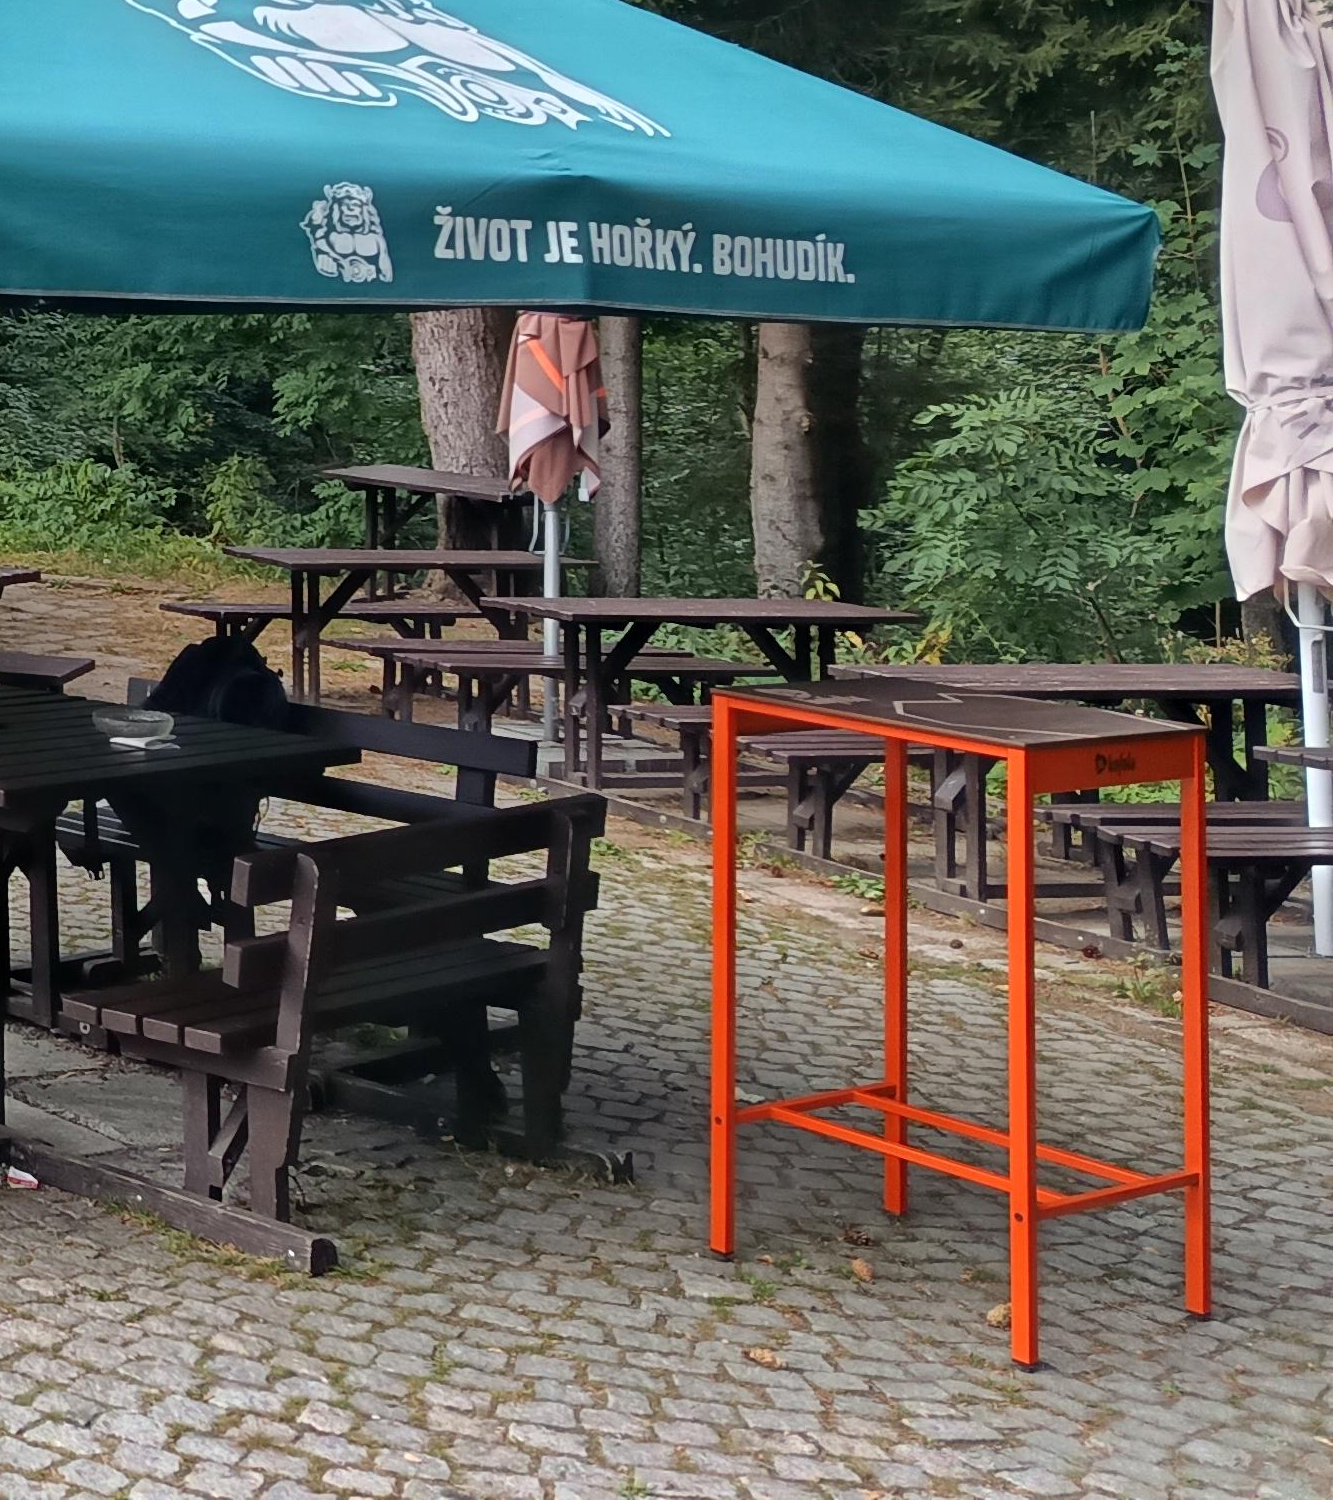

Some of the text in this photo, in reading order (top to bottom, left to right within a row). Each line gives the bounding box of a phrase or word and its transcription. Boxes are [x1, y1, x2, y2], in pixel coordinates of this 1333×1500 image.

[433, 205, 856, 283] ŽIVOT JE HOŘKÝ. BOHUDÍK.
